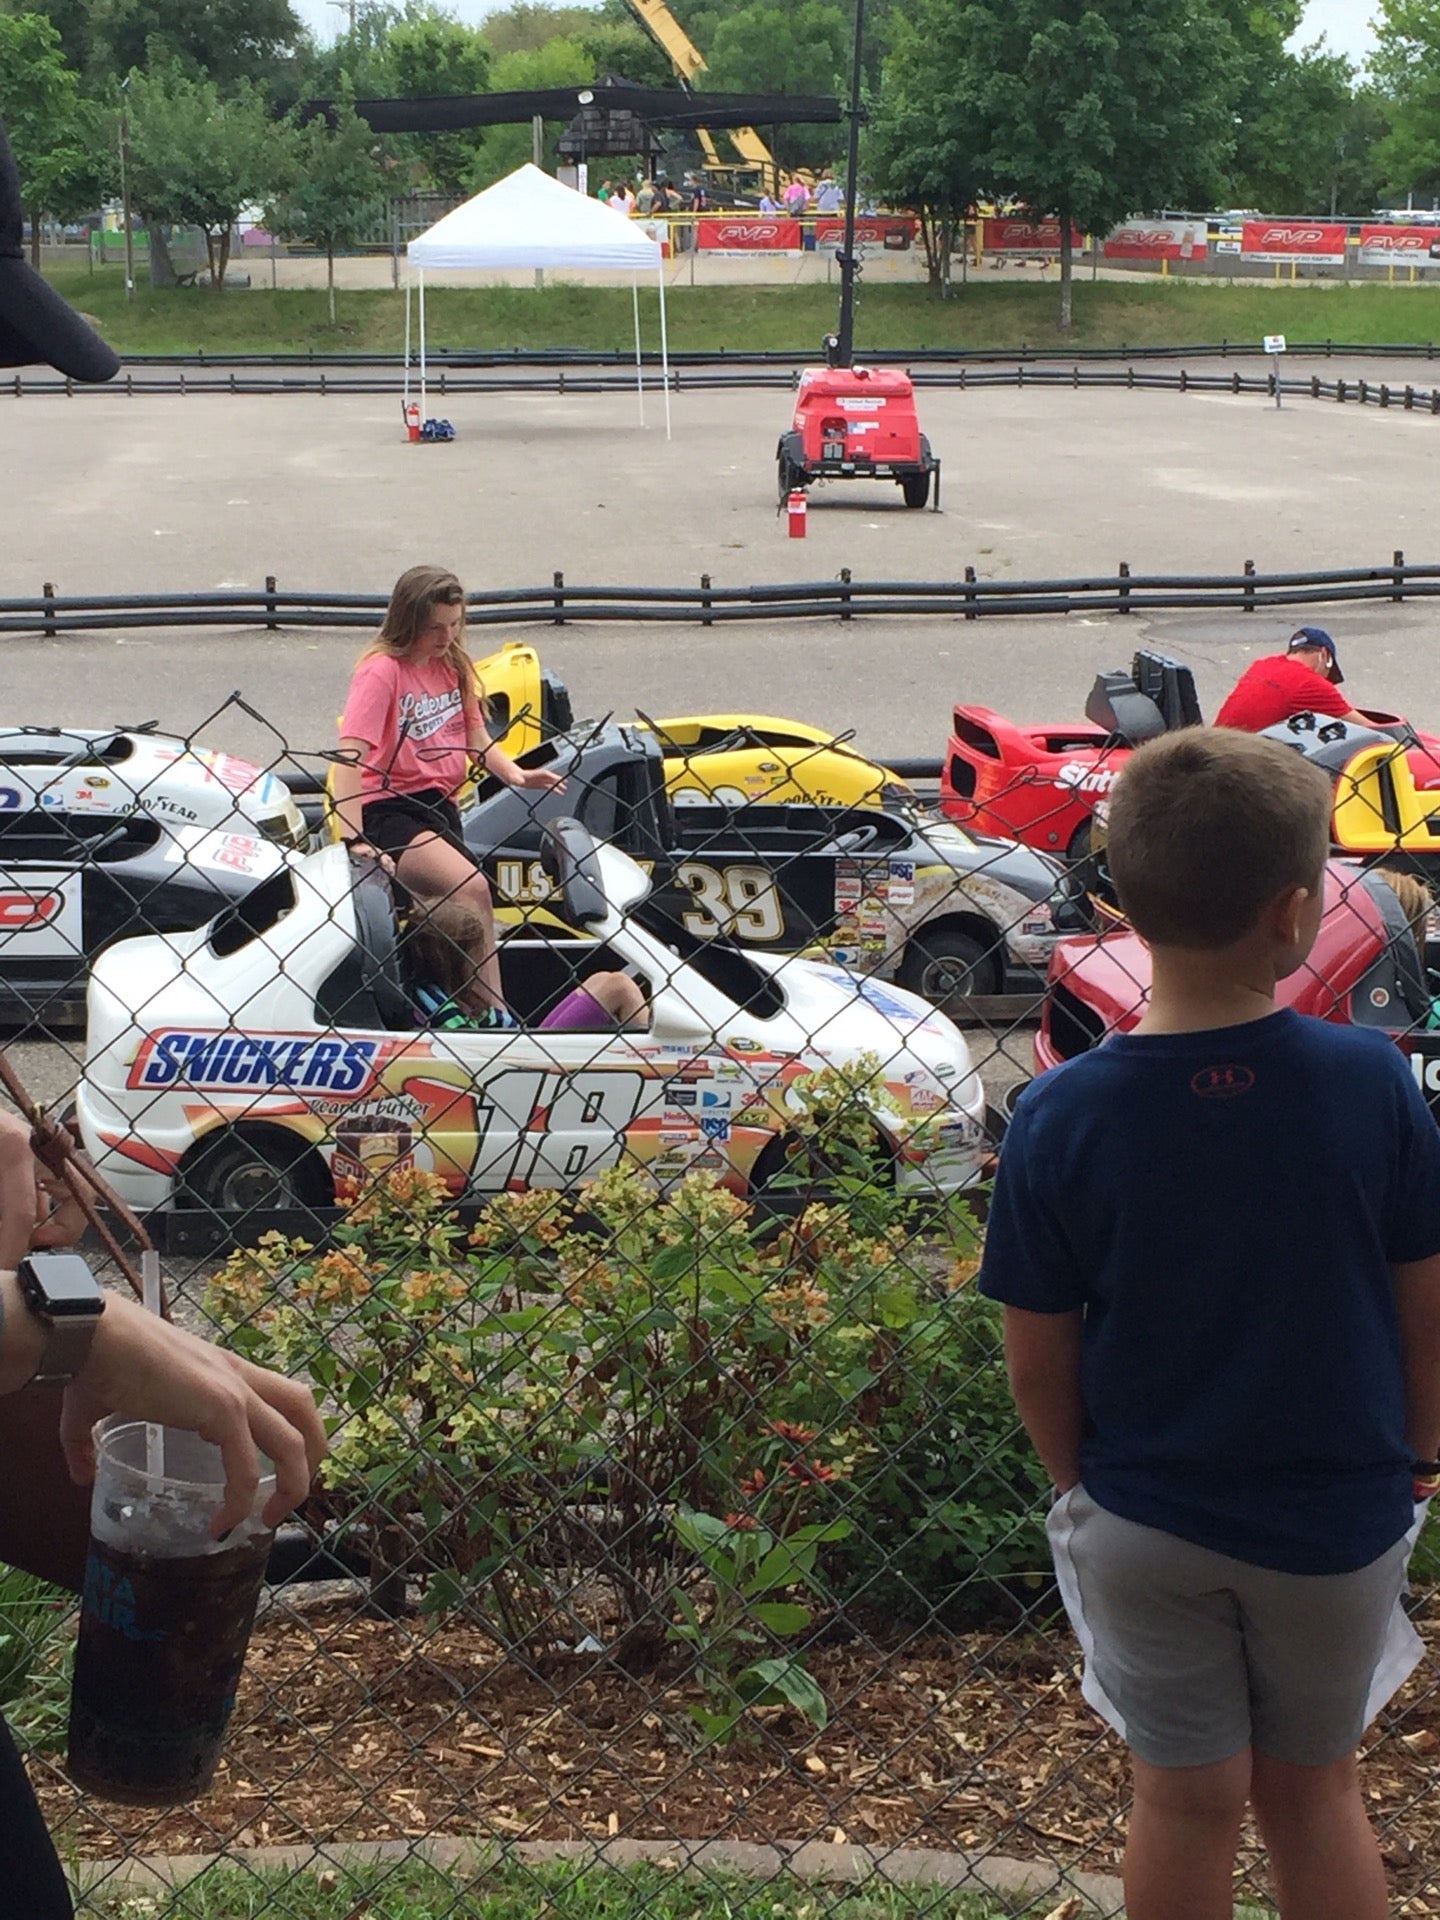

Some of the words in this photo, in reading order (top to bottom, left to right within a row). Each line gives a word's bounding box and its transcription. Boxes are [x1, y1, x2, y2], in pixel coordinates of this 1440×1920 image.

[718, 225, 779, 241] FVP
[1115, 229, 1175, 245] FVP
[1261, 228, 1324, 246] FVP
[1362, 235, 1424, 252] FVP
[399, 688, 462, 723] Letterme
[673, 862, 785, 942] 39
[144, 1034, 376, 1091] SNICKERS
[467, 1069, 645, 1194] 18
